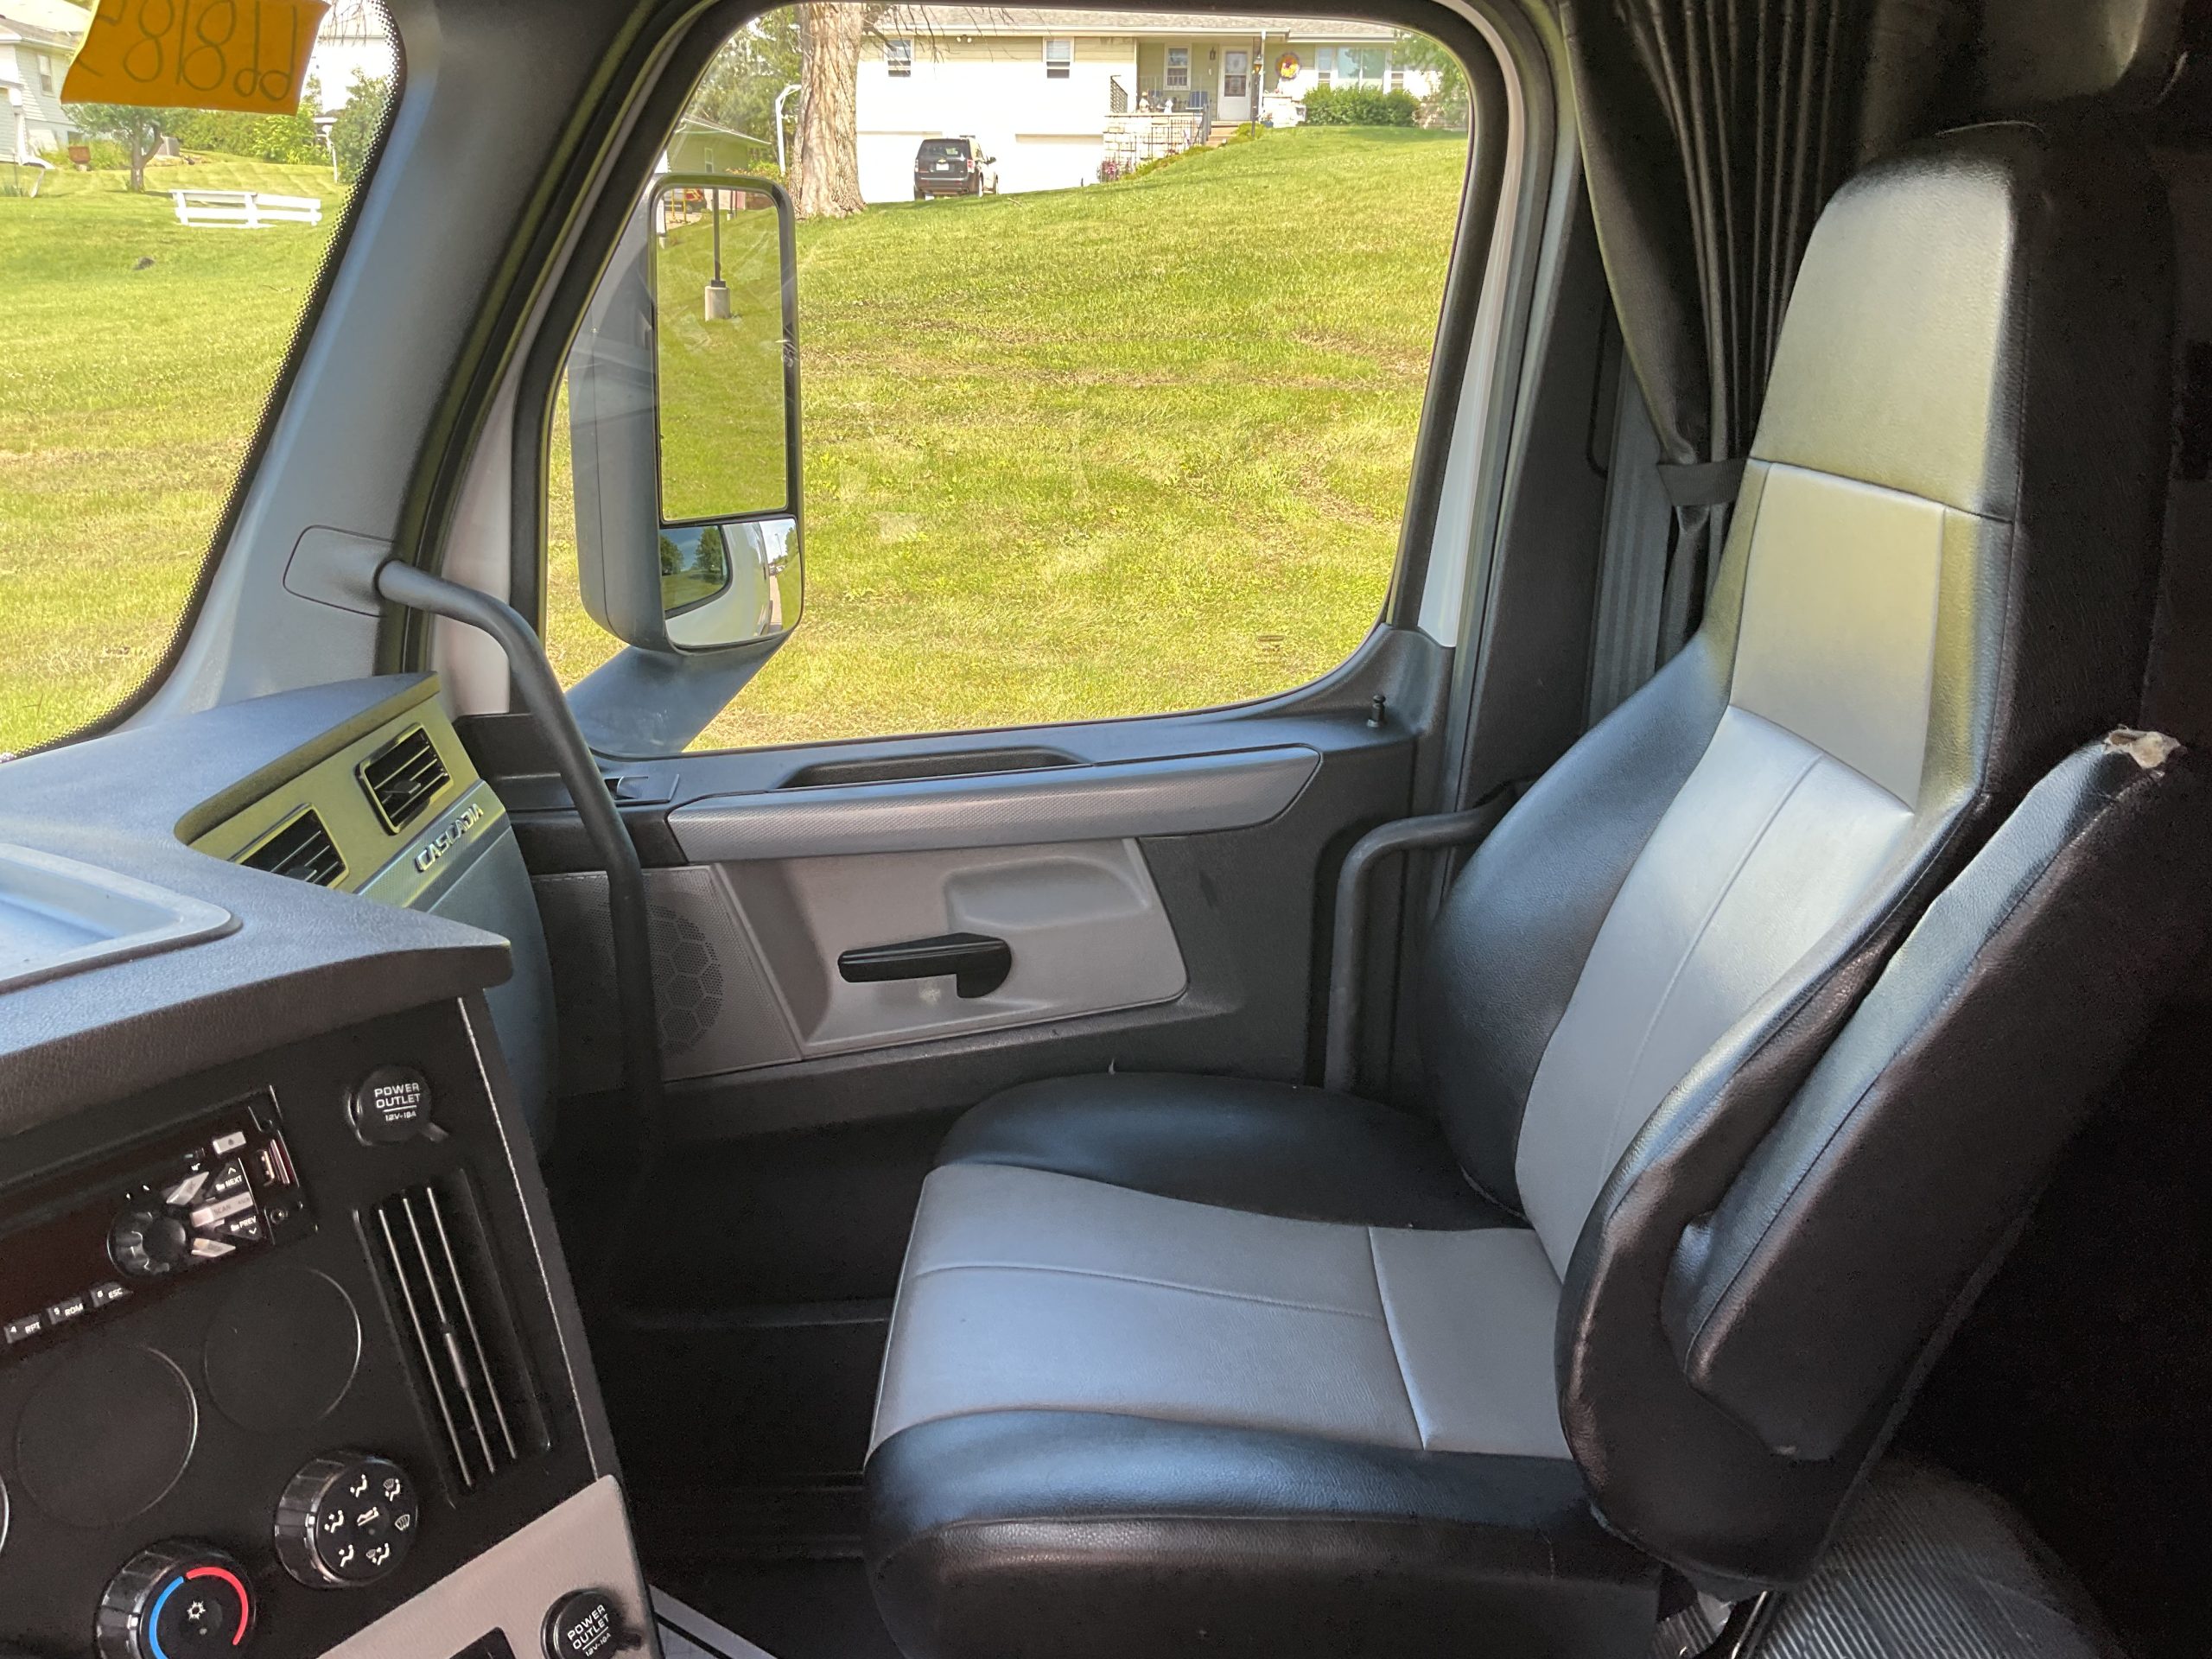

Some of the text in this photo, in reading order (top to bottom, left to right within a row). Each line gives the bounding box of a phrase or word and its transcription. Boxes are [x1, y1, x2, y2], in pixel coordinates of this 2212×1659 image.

[415, 804, 484, 872] CASCADIA
[374, 1083, 420, 1097] POWER
[376, 1093, 421, 1109] OUTLET
[225, 1175, 243, 1187] NEXT
[213, 1204, 232, 1216] SCAN
[239, 1216, 257, 1229] PREV
[108, 1287, 124, 1299] ESC
[25, 1321, 41, 1334] RPT
[567, 1605, 606, 1641] POWER
[572, 1613, 609, 1649] OUTLET
